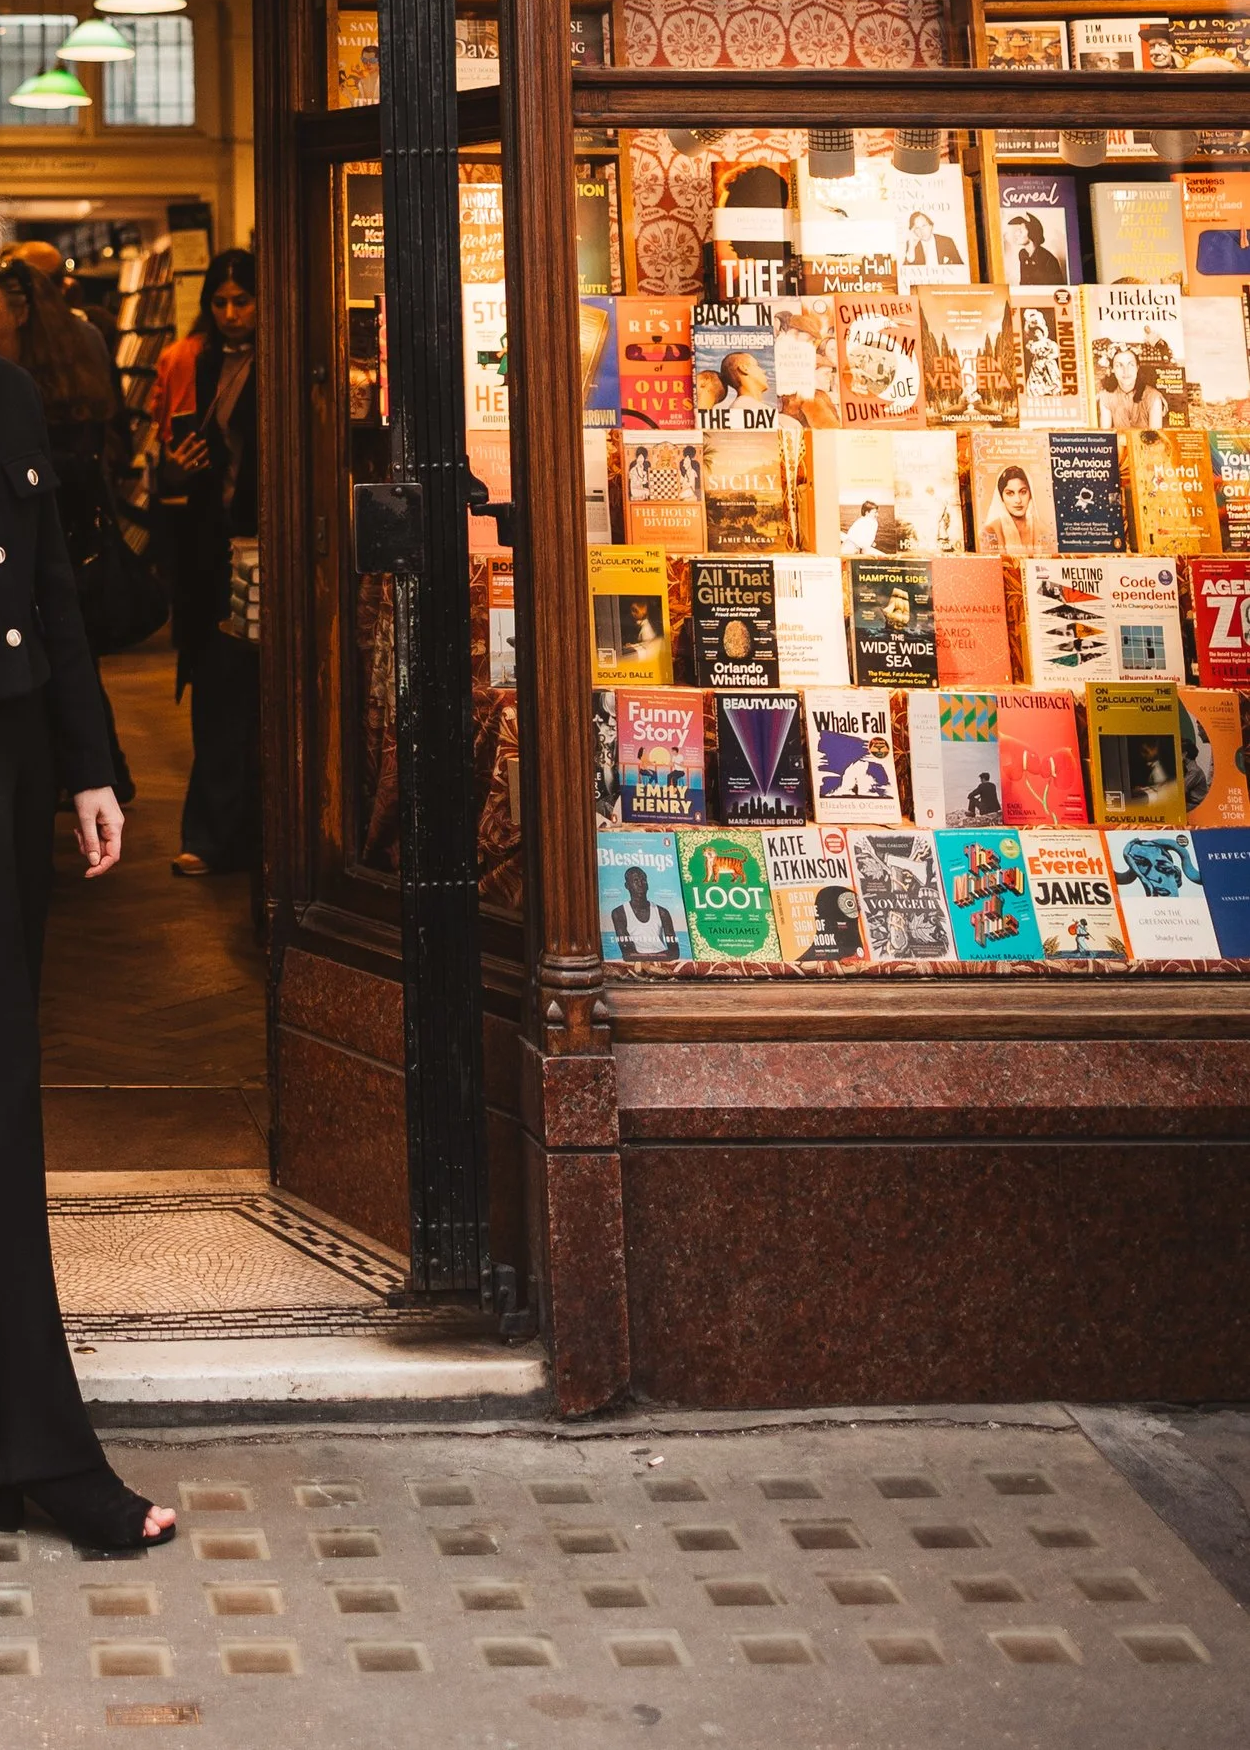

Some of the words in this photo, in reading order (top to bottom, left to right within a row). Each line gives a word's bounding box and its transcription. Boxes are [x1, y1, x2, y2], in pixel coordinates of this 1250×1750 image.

[1085, 25, 1102, 33] TIM
[1086, 34, 1133, 44] BOUVERIE
[1002, 183, 1059, 206] Surreal
[812, 261, 859, 276] Marble
[864, 259, 891, 274] Hall
[824, 276, 883, 292] Murders
[1109, 290, 1175, 306] Hidden
[694, 304, 740, 325] BACK
[756, 305, 772, 325] IN
[840, 303, 912, 323] CHILDREN
[1098, 306, 1177, 321] Portraits
[629, 320, 684, 332] REST
[695, 335, 725, 345] OLIVER
[844, 329, 915, 357] RADIUM
[934, 357, 1001, 372] EINSTEIN
[1057, 321, 1077, 396] MURDER
[635, 380, 685, 393] OUR
[890, 378, 916, 399] JOE
[926, 373, 1011, 390] VENDETTA
[627, 397, 693, 411] LIVES
[699, 409, 730, 429] THE
[744, 409, 775, 428] DAY
[1052, 458, 1072, 468] The
[1073, 458, 1111, 469] Anxious
[1054, 467, 1109, 479] Generation
[1154, 464, 1198, 478] Mortal
[708, 476, 777, 490] SICILY
[1153, 478, 1203, 492] Secrets
[635, 509, 657, 517] THE
[661, 509, 698, 517] HOUSE
[643, 518, 691, 527] DIVIDED
[698, 569, 722, 586] All
[727, 570, 770, 586] That
[859, 575, 903, 583] HAMPTON
[905, 575, 928, 583] SIDES
[1062, 567, 1103, 580] MELTING
[1072, 581, 1100, 593] POINT
[1120, 576, 1156, 588] Code
[698, 587, 772, 605] Glitters
[936, 629, 970, 637] CARLO
[860, 642, 896, 654] WIDE
[900, 643, 933, 655] WIDE
[714, 663, 763, 673] Orlando
[886, 655, 912, 668] SEA
[710, 674, 768, 685] Whitfield
[723, 698, 797, 710] BEAUTYLAND
[996, 696, 1070, 710] HUNCHBACK
[628, 702, 693, 729] Funny
[813, 711, 859, 733] Whale
[862, 711, 886, 733] Fall
[633, 721, 689, 748] Story
[636, 784, 688, 798] EMILY
[632, 798, 692, 814] HENRY
[768, 836, 806, 857] KATE
[1039, 848, 1087, 858] Percival
[598, 849, 674, 871] Blessings
[1028, 857, 1103, 875] Everett
[773, 858, 848, 881] ATKINSON
[692, 886, 764, 909] LOOT
[788, 892, 815, 904] DEATH
[1036, 882, 1111, 905] JAMES
[792, 906, 802, 916] AT
[804, 905, 819, 916] THE
[870, 898, 937, 909] VOYAGEUR
[794, 921, 813, 933] SIGN
[815, 921, 825, 932] OF
[795, 934, 811, 947] THE
[814, 933, 836, 946] ROOK
